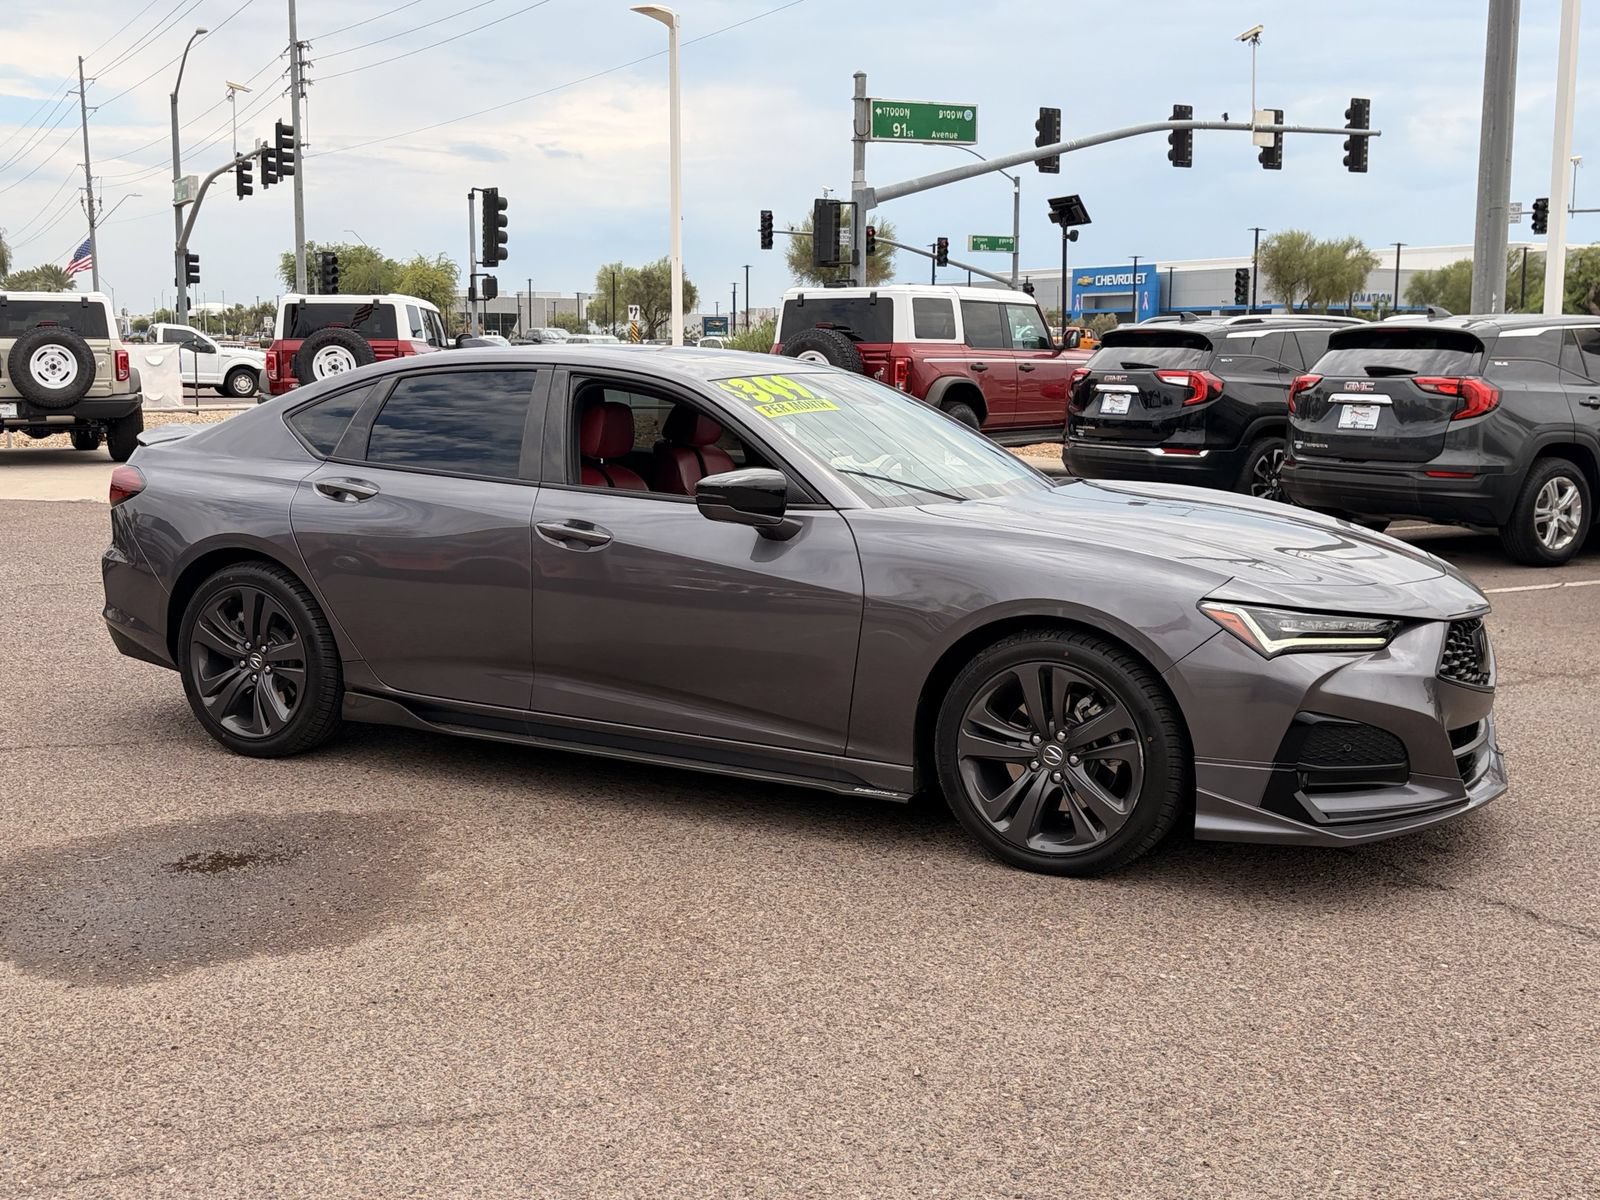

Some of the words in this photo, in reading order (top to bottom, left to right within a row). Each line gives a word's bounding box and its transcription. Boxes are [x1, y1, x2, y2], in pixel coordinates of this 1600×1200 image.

[892, 122, 914, 137] 91st
[931, 130, 958, 139] Avenue
[1095, 273, 1147, 286] CHEVROLET
[1344, 381, 1376, 392] GMC
[762, 403, 790, 414] PER
[788, 400, 830, 412] MONTH
